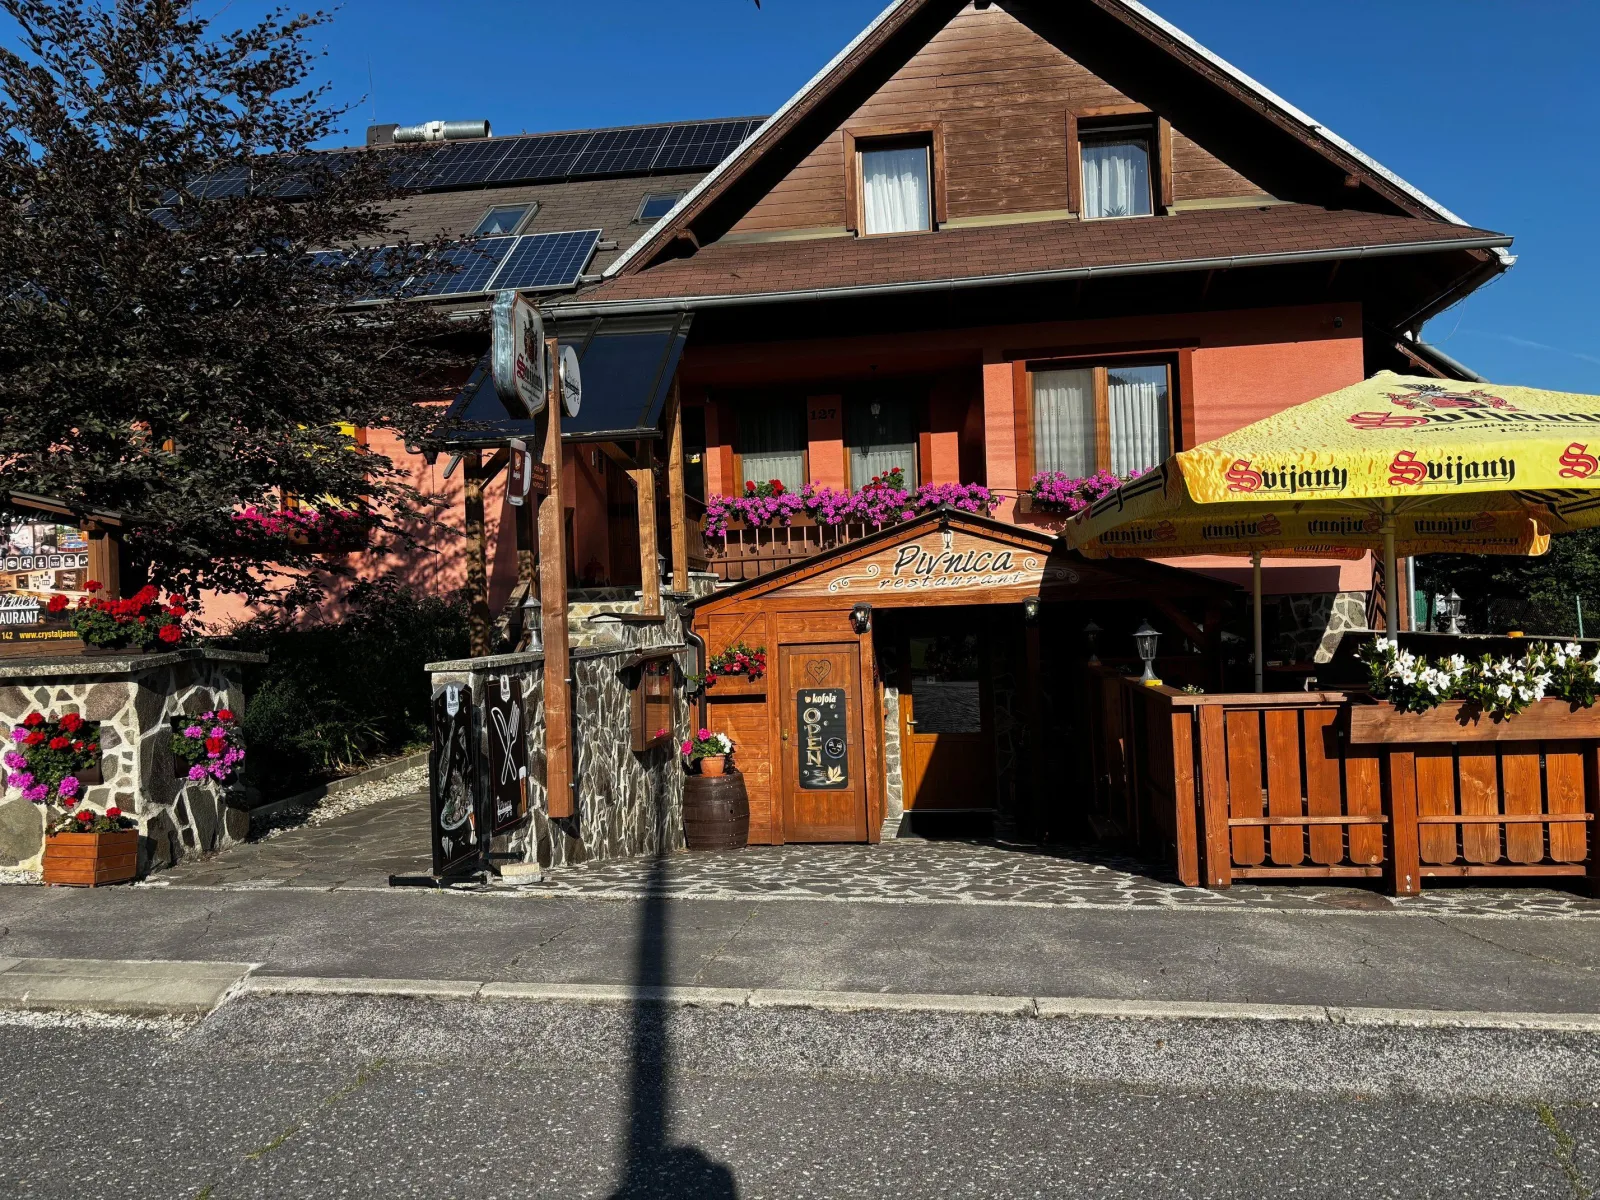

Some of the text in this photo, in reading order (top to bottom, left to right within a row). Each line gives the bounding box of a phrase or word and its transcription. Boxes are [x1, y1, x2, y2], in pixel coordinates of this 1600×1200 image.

[810, 408, 836, 420] 127
[1224, 459, 1348, 494] Svijany
[1388, 450, 1516, 486] Svijany
[894, 545, 1015, 576] Pivnica
[879, 571, 1025, 589] restaurant
[2, 632, 13, 640] 142
[812, 693, 837, 706] kofola
[803, 707, 824, 768] OPEN
